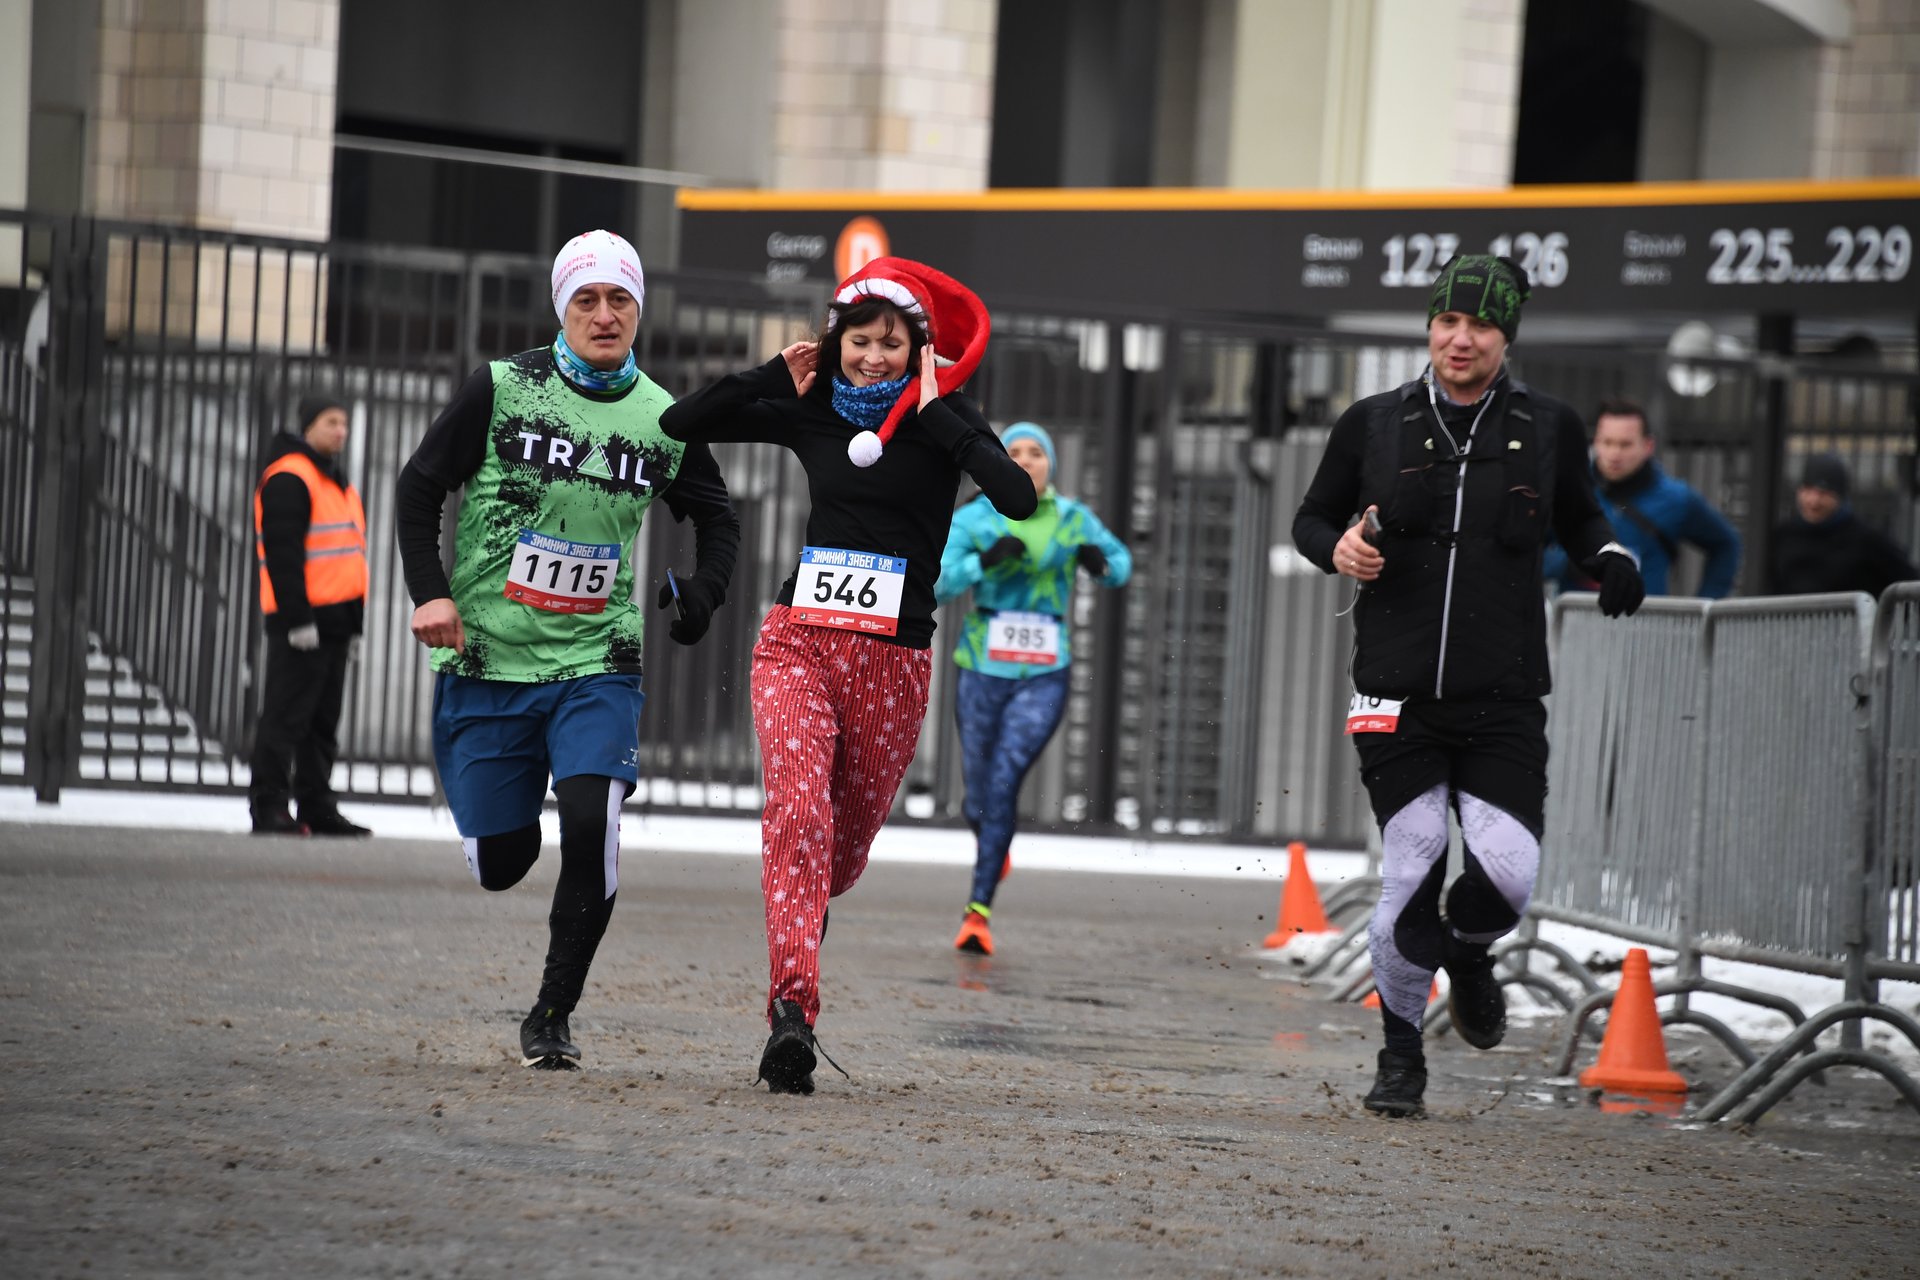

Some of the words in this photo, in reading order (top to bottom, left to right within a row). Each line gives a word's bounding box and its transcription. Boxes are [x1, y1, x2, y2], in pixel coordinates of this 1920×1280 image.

[518, 430, 651, 487] TRAIL
[530, 534, 570, 554] ЗИМНИЙ
[570, 544, 597, 558] ЗАБЕГ
[811, 550, 847, 565] ЗИМНИЙ
[847, 553, 876, 568] ЗАБЕГ
[525, 554, 608, 593] 1115
[813, 571, 878, 608] 546
[1003, 625, 1046, 650] 985
